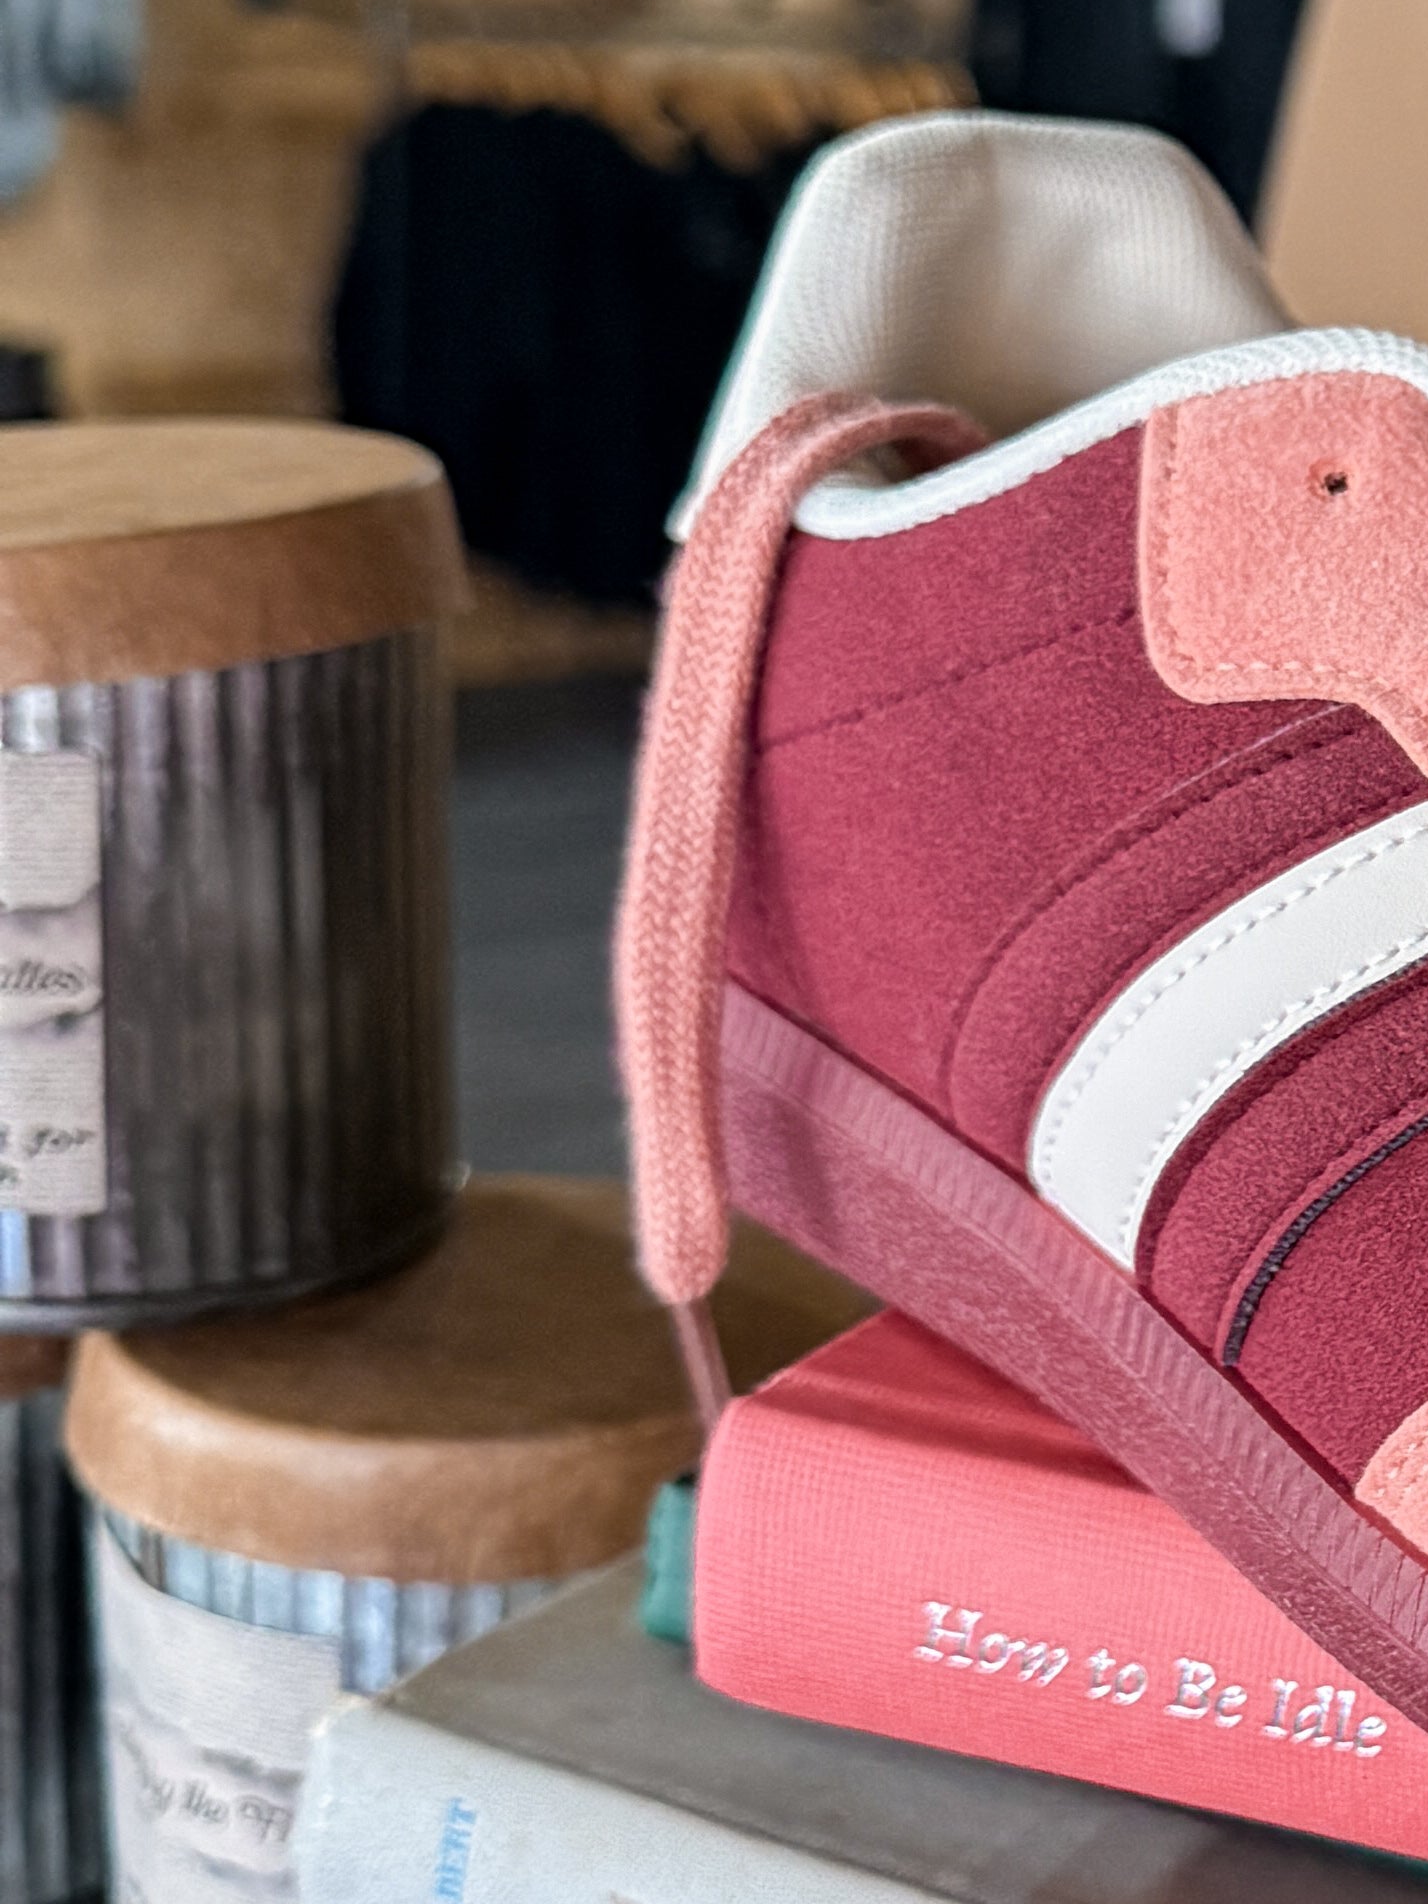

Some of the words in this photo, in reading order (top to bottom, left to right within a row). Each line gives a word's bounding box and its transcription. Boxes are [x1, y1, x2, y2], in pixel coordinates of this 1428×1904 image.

[913, 1600, 1070, 1687] How
[1086, 1648, 1148, 1706] to
[1163, 1656, 1249, 1729] Be
[1262, 1677, 1388, 1758] Idle
